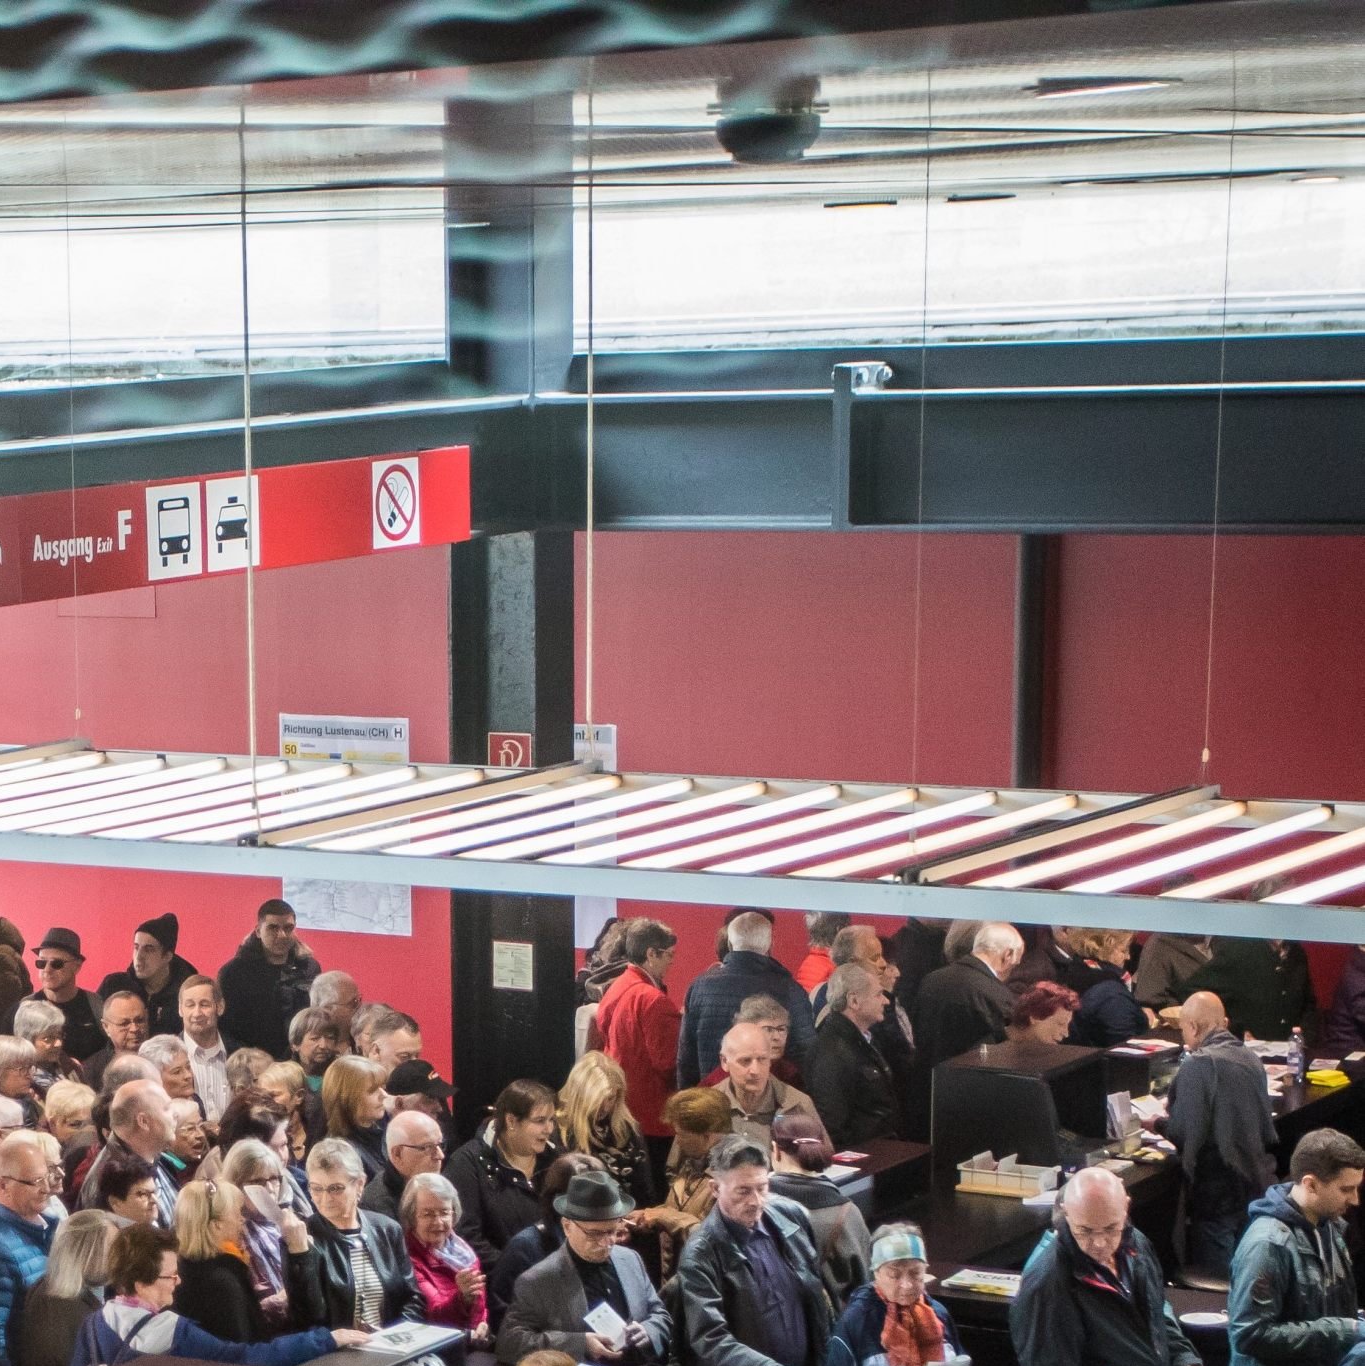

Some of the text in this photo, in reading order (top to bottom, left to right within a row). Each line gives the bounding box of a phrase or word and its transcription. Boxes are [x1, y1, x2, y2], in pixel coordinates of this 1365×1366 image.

[33, 509, 132, 567] Ausgang Exit F
[283, 724, 403, 739] Richtung Lustenau (CH) H
[284, 744, 297, 755] 50
